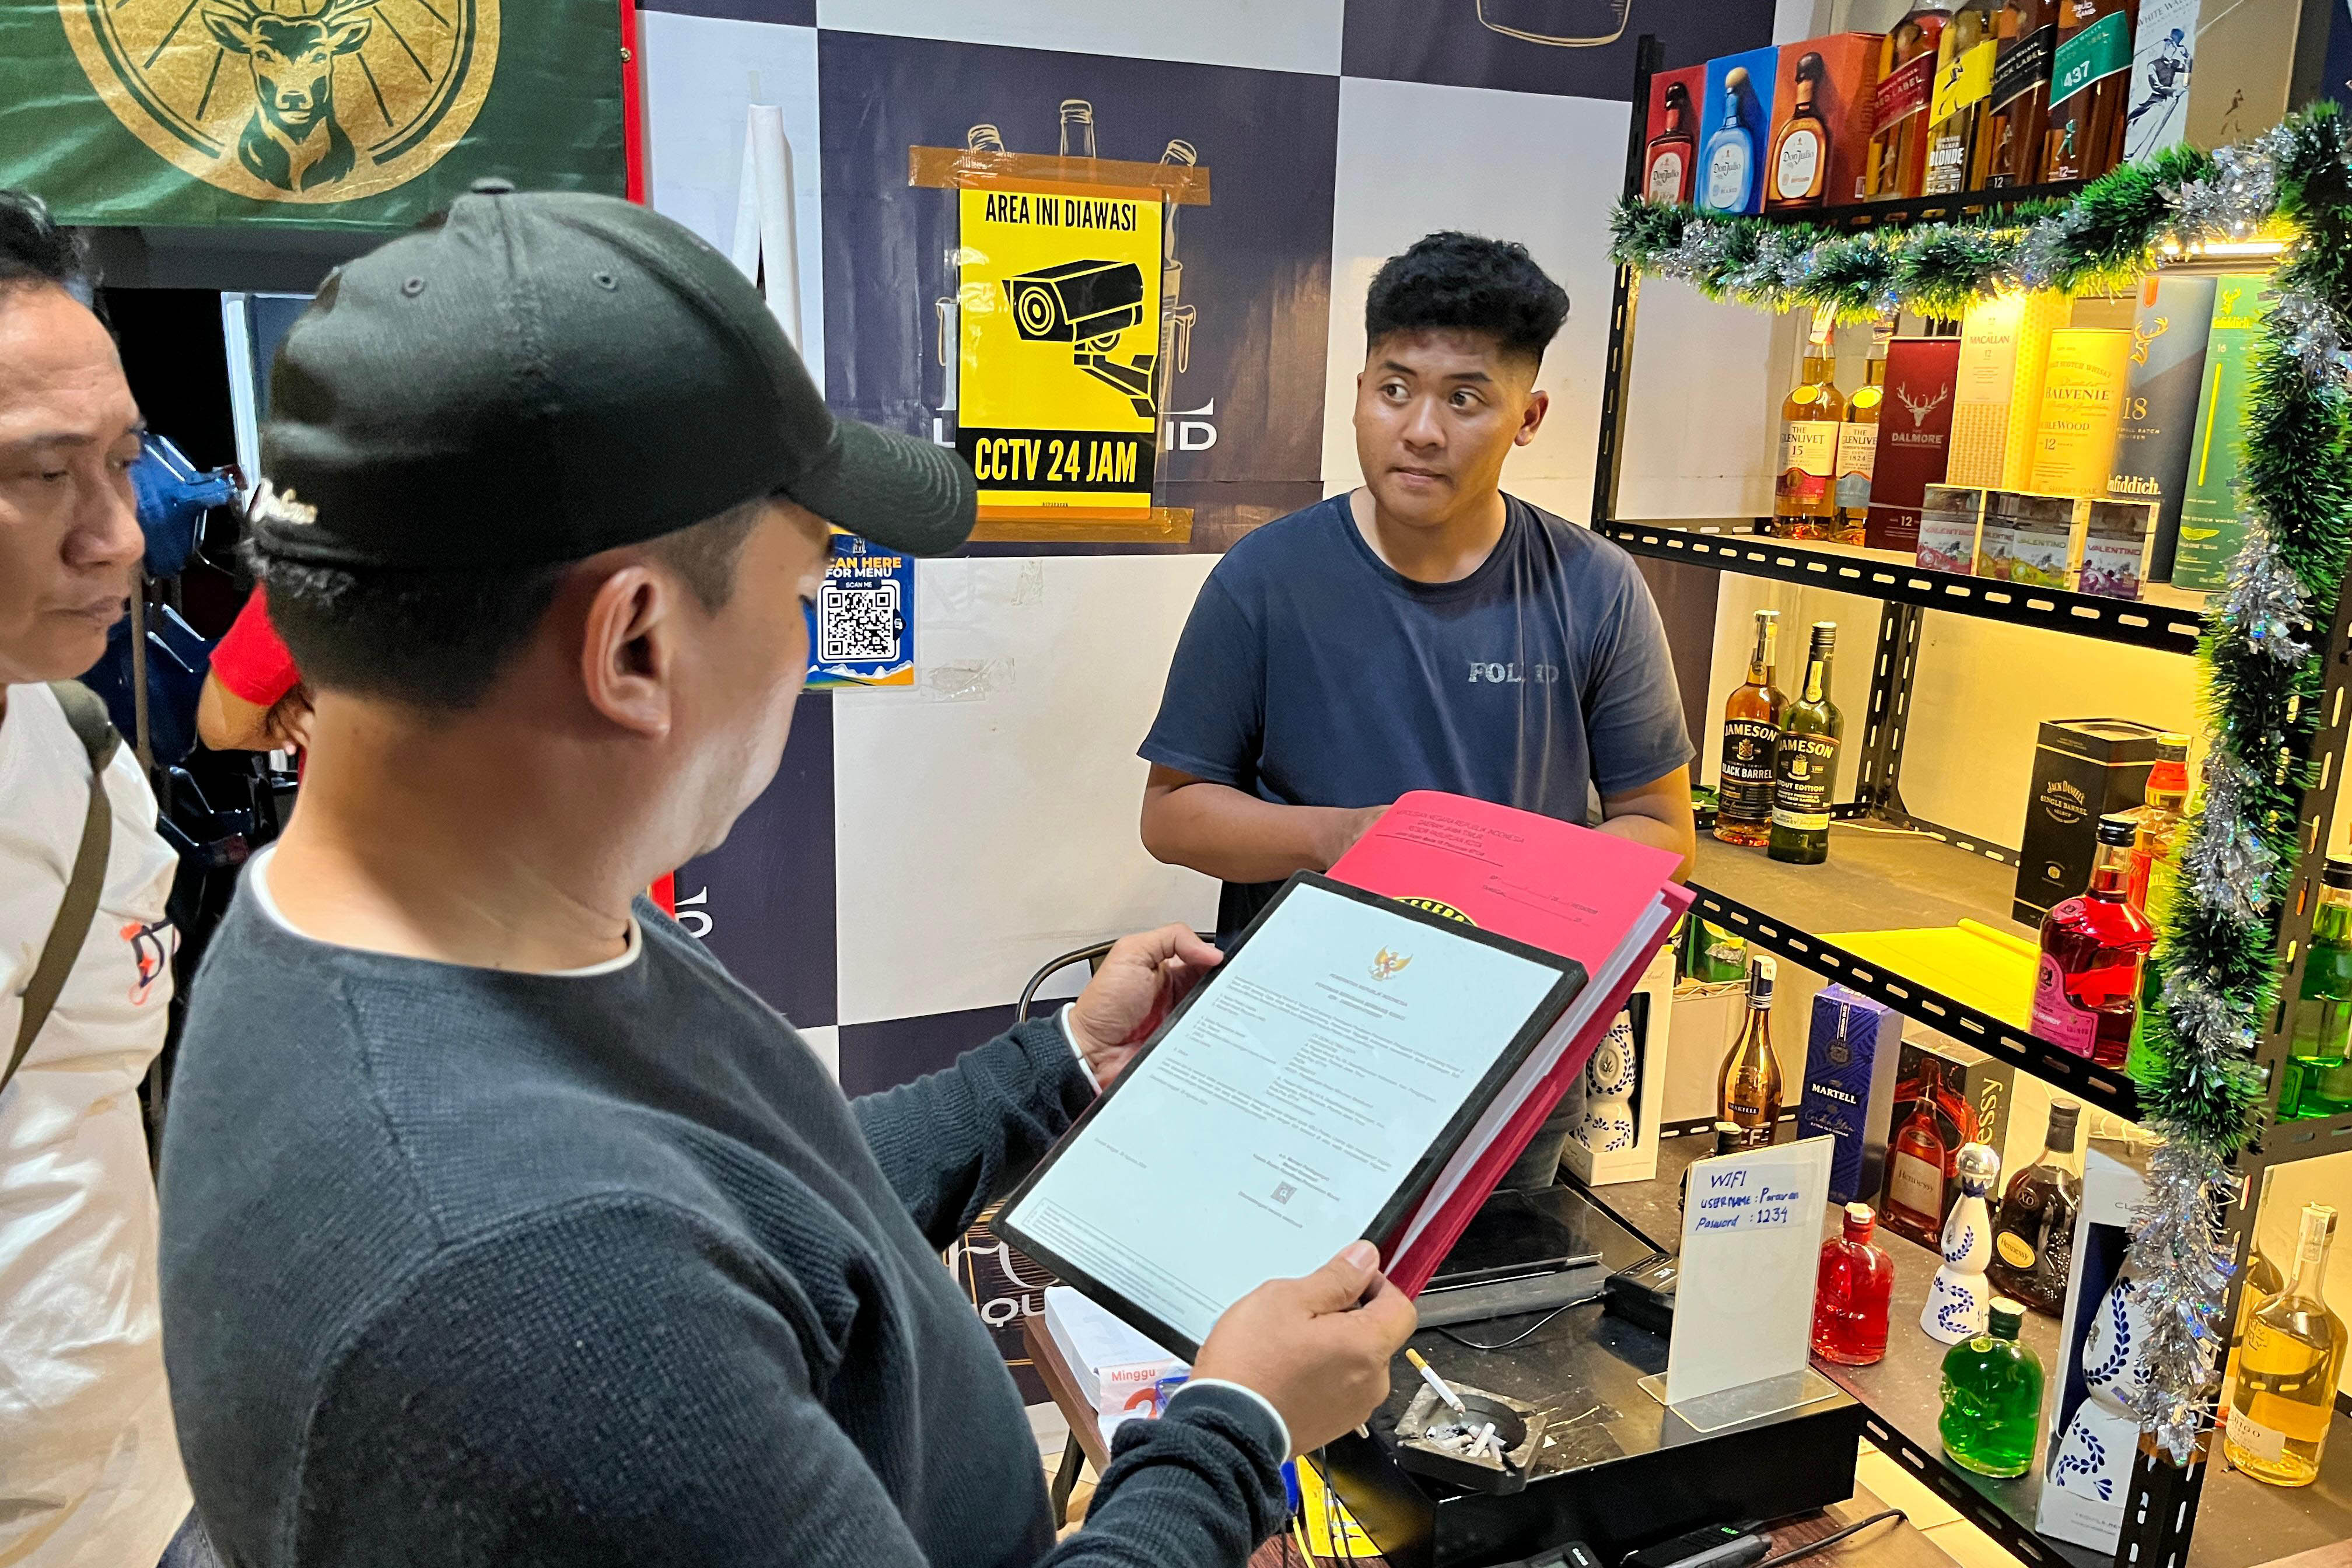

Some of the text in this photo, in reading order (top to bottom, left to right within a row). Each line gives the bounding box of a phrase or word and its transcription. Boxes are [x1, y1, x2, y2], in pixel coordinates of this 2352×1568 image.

[2064, 60, 2090, 86] 437
[1929, 148, 1964, 167] BLONDE
[1994, 177, 2003, 188] 12
[985, 194, 1138, 232] AREA INI DIAWASI
[2046, 387, 2110, 400] BALVENIE
[2123, 397, 2147, 420] 18
[1842, 436, 1877, 444] GLENLIVE
[1891, 433, 1944, 444] DALMORE
[2044, 438, 2056, 450] 12
[1793, 446, 1804, 455] 15
[975, 438, 1138, 483] CCTV 24 JAM
[1901, 516, 1912, 526] 12
[2017, 538, 2066, 548] VALENTINO
[2088, 544, 2141, 555] VALENTINO
[862, 557, 902, 568] HERE
[825, 568, 892, 578] FOR MENU
[1725, 724, 1777, 742] JAMESON
[1779, 740, 1833, 759] JAMESON
[1741, 768, 1772, 779] BARREL
[1794, 784, 1825, 792] EDITION
[2041, 795, 2088, 816] SINGLE BARREL
[1812, 1083, 1856, 1104] MARTELL
[1730, 1104, 1756, 1114] MARTELL
[1976, 1078, 2003, 1144] essy
[1711, 1171, 1747, 1188] WIFI
[1899, 1170, 1933, 1192] Hennessy
[1700, 1196, 1751, 1209] USERNAME
[2019, 1191, 2034, 1205] XO
[2001, 1237, 2029, 1261] Hennessy
[1111, 1368, 1156, 1382] Minggu
